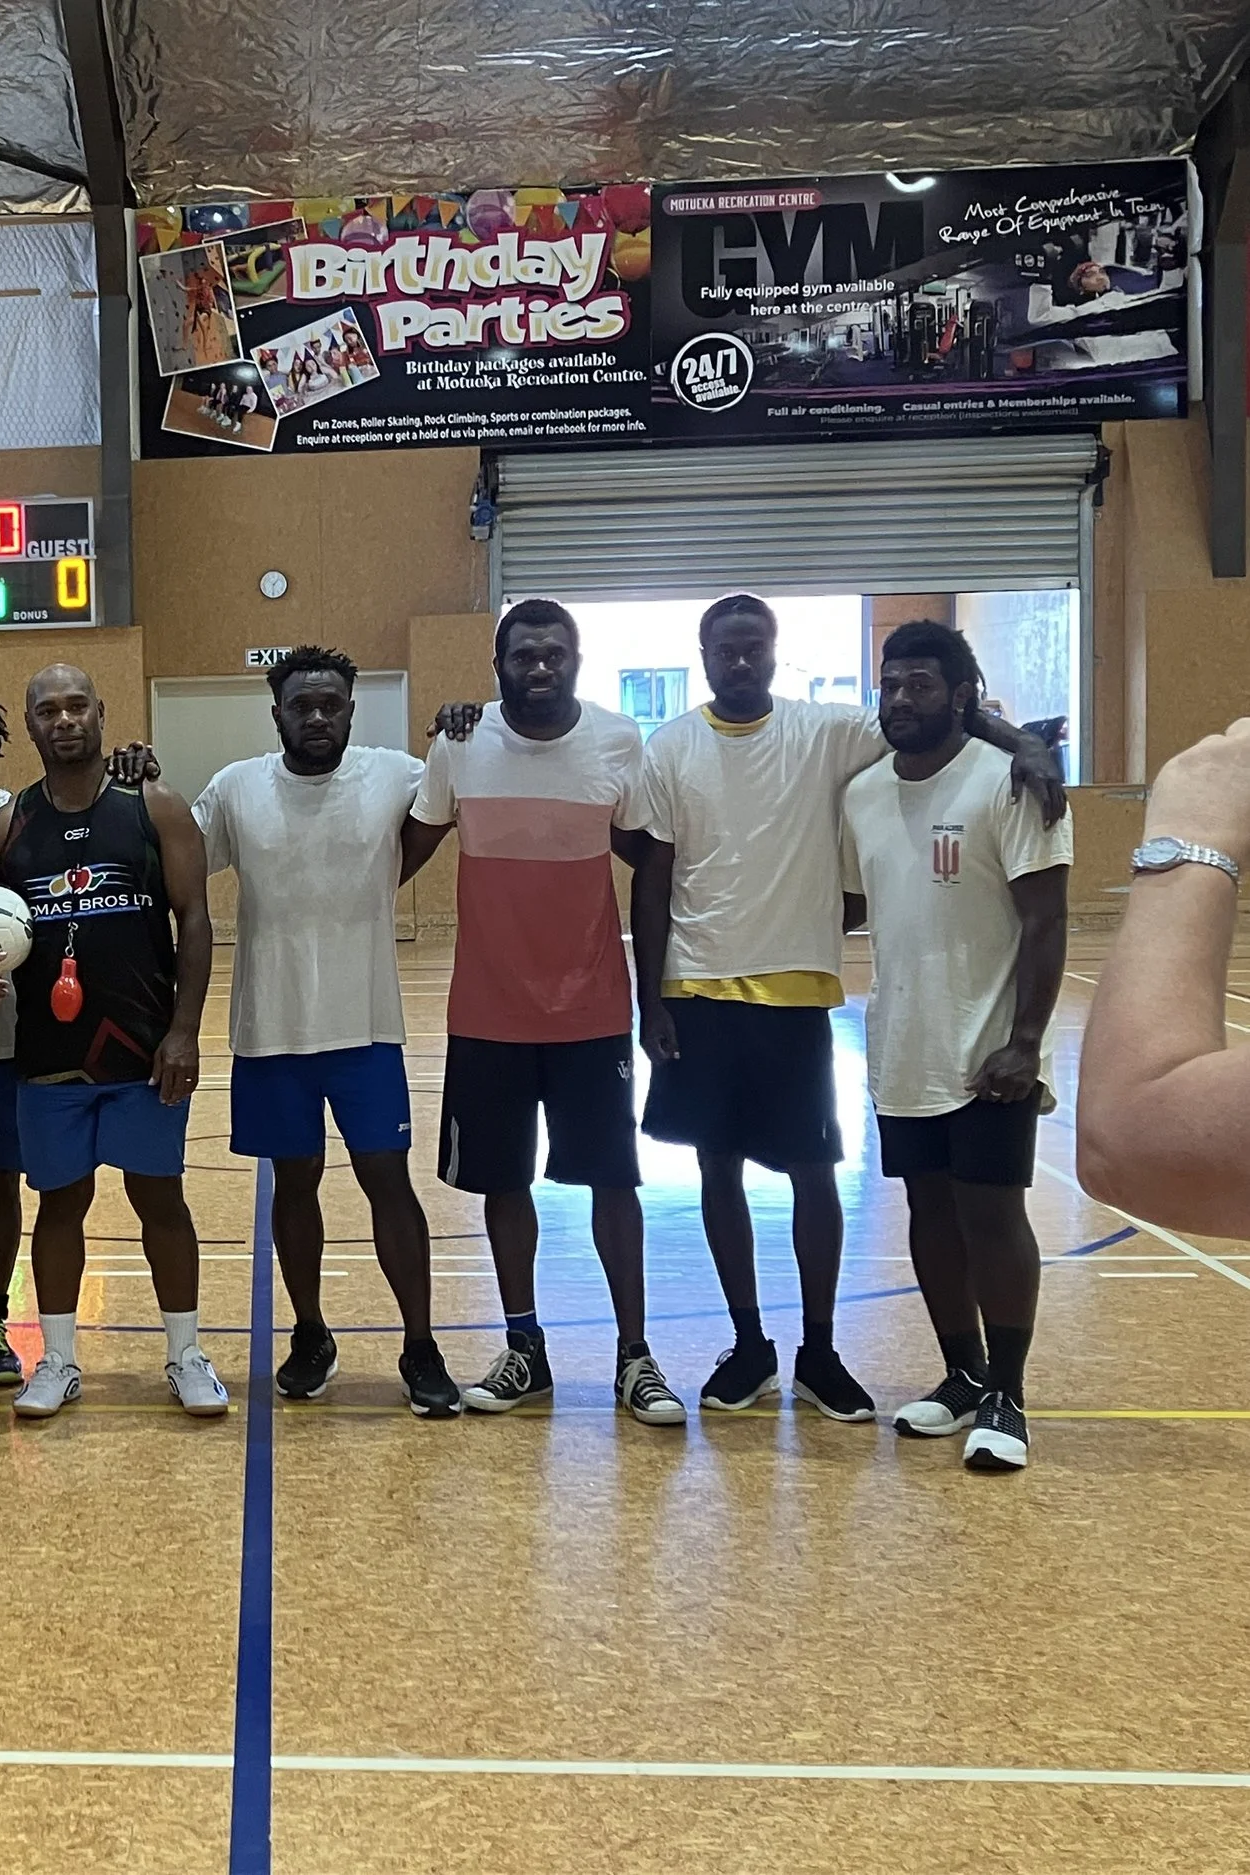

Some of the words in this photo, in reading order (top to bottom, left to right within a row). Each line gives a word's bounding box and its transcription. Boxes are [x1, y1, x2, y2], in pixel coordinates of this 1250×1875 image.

[670, 197, 716, 211] MOTUEKA
[718, 195, 776, 209] RECREATION
[778, 193, 816, 206] CENTRE
[964, 202, 1008, 221] Most
[1015, 184, 1122, 213] Comprehensive
[939, 226, 992, 245] Range
[996, 217, 1024, 236] Of
[1028, 208, 1103, 233] Equipment
[1110, 201, 1125, 217] In
[1125, 197, 1166, 213] Town
[288, 232, 609, 301] Birthday
[680, 201, 924, 319] GYM
[700, 286, 733, 301] Fully
[735, 282, 800, 299] equipped
[802, 283, 833, 298] gym
[835, 278, 895, 293] available
[750, 302, 781, 316] here
[783, 303, 798, 315] at
[800, 301, 824, 315] the
[376, 296, 626, 351] Parties
[406, 359, 472, 376] Birthday
[475, 356, 545, 375] packages
[548, 352, 617, 369] available
[681, 347, 737, 385] 24/7
[417, 377, 432, 391] at
[436, 374, 502, 391] Motueka
[506, 371, 589, 389] Recreation
[593, 368, 648, 384] Centre.
[691, 378, 726, 394] access
[767, 407, 789, 417] Full
[791, 405, 807, 416] air
[809, 403, 886, 415] conditioning.
[902, 401, 941, 412] Casual
[943, 399, 984, 410] entries
[987, 399, 996, 409] &
[998, 395, 1078, 408] Memberships
[1079, 394, 1136, 405] available.
[313, 419, 330, 430] Fun
[331, 418, 359, 430] Zones,
[360, 417, 386, 428] Roller
[387, 415, 422, 429] Skating,
[424, 414, 446, 425] Rock
[447, 411, 489, 426] Climbing,
[490, 411, 519, 424] Sports
[520, 412, 530, 422] or
[531, 408, 587, 421] combination
[588, 407, 632, 420] packages.
[296, 434, 330, 446] Enquire
[331, 434, 341, 444] at
[342, 430, 383, 444] reception
[384, 431, 394, 441] or
[395, 430, 411, 443] get
[411, 431, 418, 440] a
[419, 428, 439, 440] hold
[440, 427, 450, 439] of
[451, 429, 462, 439] us
[462, 427, 476, 438] via
[477, 426, 508, 439] phone,
[508, 424, 533, 436] email
[534, 426, 544, 435] or
[545, 422, 587, 434] facebook
[587, 421, 600, 433] for
[601, 422, 626, 432] more
[626, 420, 647, 431] info.
[26, 540, 91, 559] GUEST
[57, 557, 88, 609] 0
[12, 610, 49, 621] BONUS
[247, 649, 290, 665] EXIT
[79, 894, 129, 911] BROS
